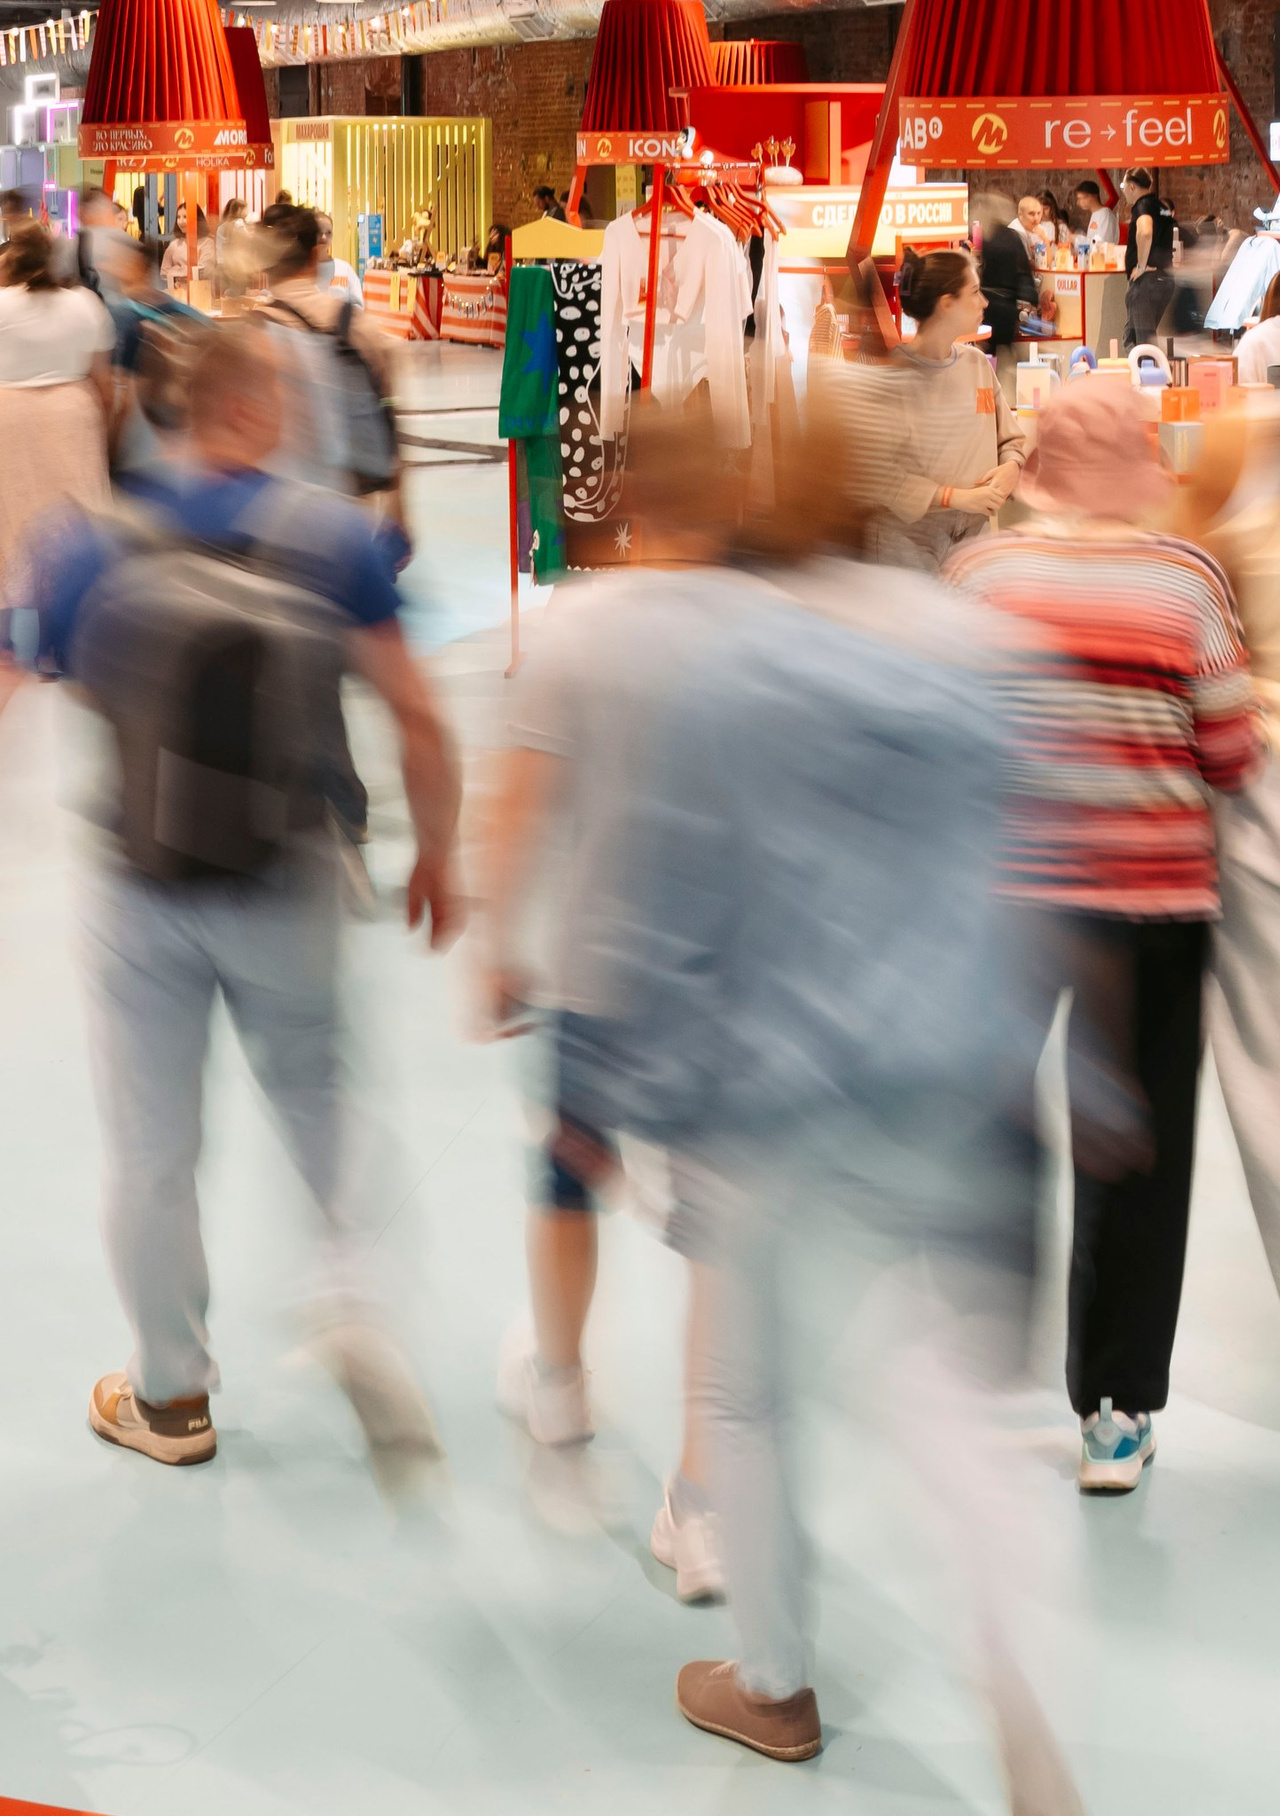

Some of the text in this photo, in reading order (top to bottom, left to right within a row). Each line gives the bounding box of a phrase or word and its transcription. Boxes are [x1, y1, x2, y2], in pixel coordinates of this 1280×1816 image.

[1121, 107, 1193, 147] feel
[110, 140, 153, 151] КРАСИВО
[629, 139, 676, 157] ICON
[908, 202, 952, 224] РОССИИ
